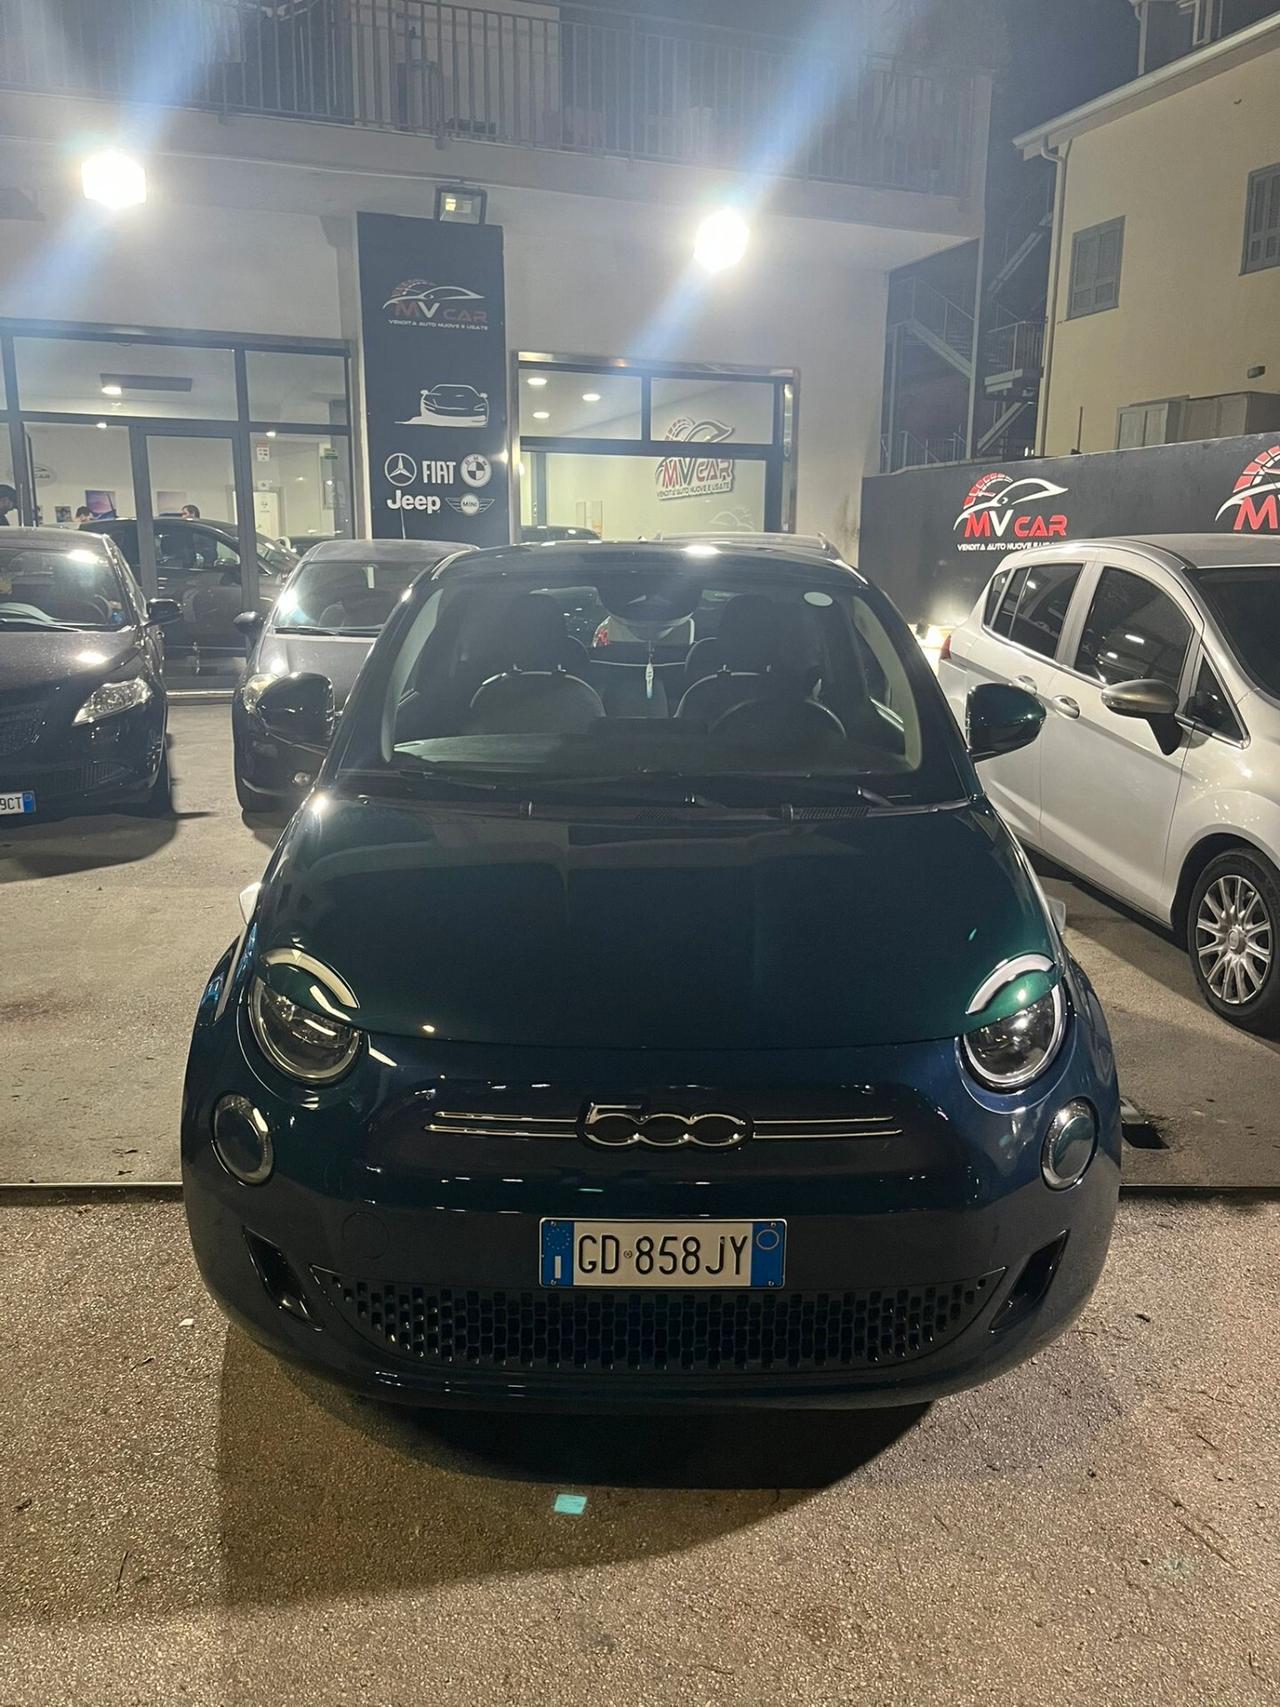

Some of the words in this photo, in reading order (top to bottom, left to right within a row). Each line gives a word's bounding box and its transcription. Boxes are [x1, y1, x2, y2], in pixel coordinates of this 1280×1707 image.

[395, 300, 440, 318] MV
[443, 308, 488, 324] CAR
[422, 460, 456, 484] FIAT
[662, 458, 697, 489] MV
[697, 458, 734, 482] CAR
[386, 489, 441, 514] Jeep
[1233, 495, 1280, 530] M
[964, 509, 1014, 538] MV
[1014, 514, 1068, 538] CAR
[957, 543, 986, 552] VENDITA
[987, 543, 1006, 551] AUTO
[584, 1101, 747, 1147] 500
